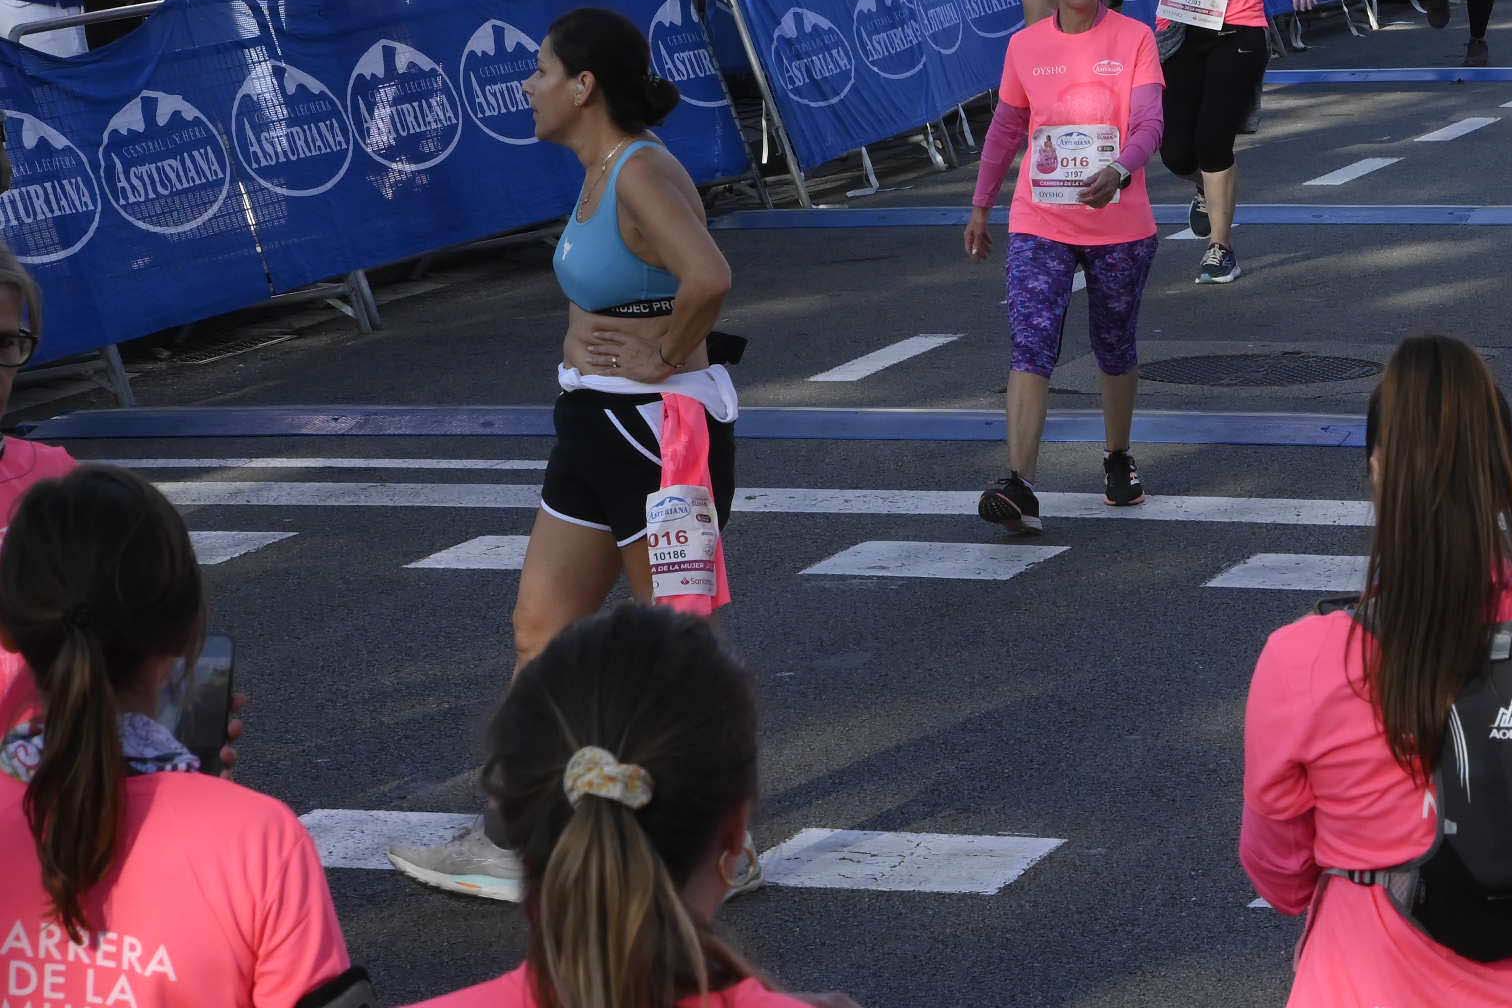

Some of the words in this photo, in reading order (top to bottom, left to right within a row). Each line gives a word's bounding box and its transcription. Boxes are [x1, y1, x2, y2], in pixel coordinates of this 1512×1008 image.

[1033, 65, 1067, 77] OYSHO
[1060, 156, 1089, 168] 016
[1065, 169, 1083, 179] 3197
[648, 529, 689, 548] 016
[653, 548, 687, 562] 10186
[8, 959, 66, 999] DE
[85, 967, 139, 1008] LA
